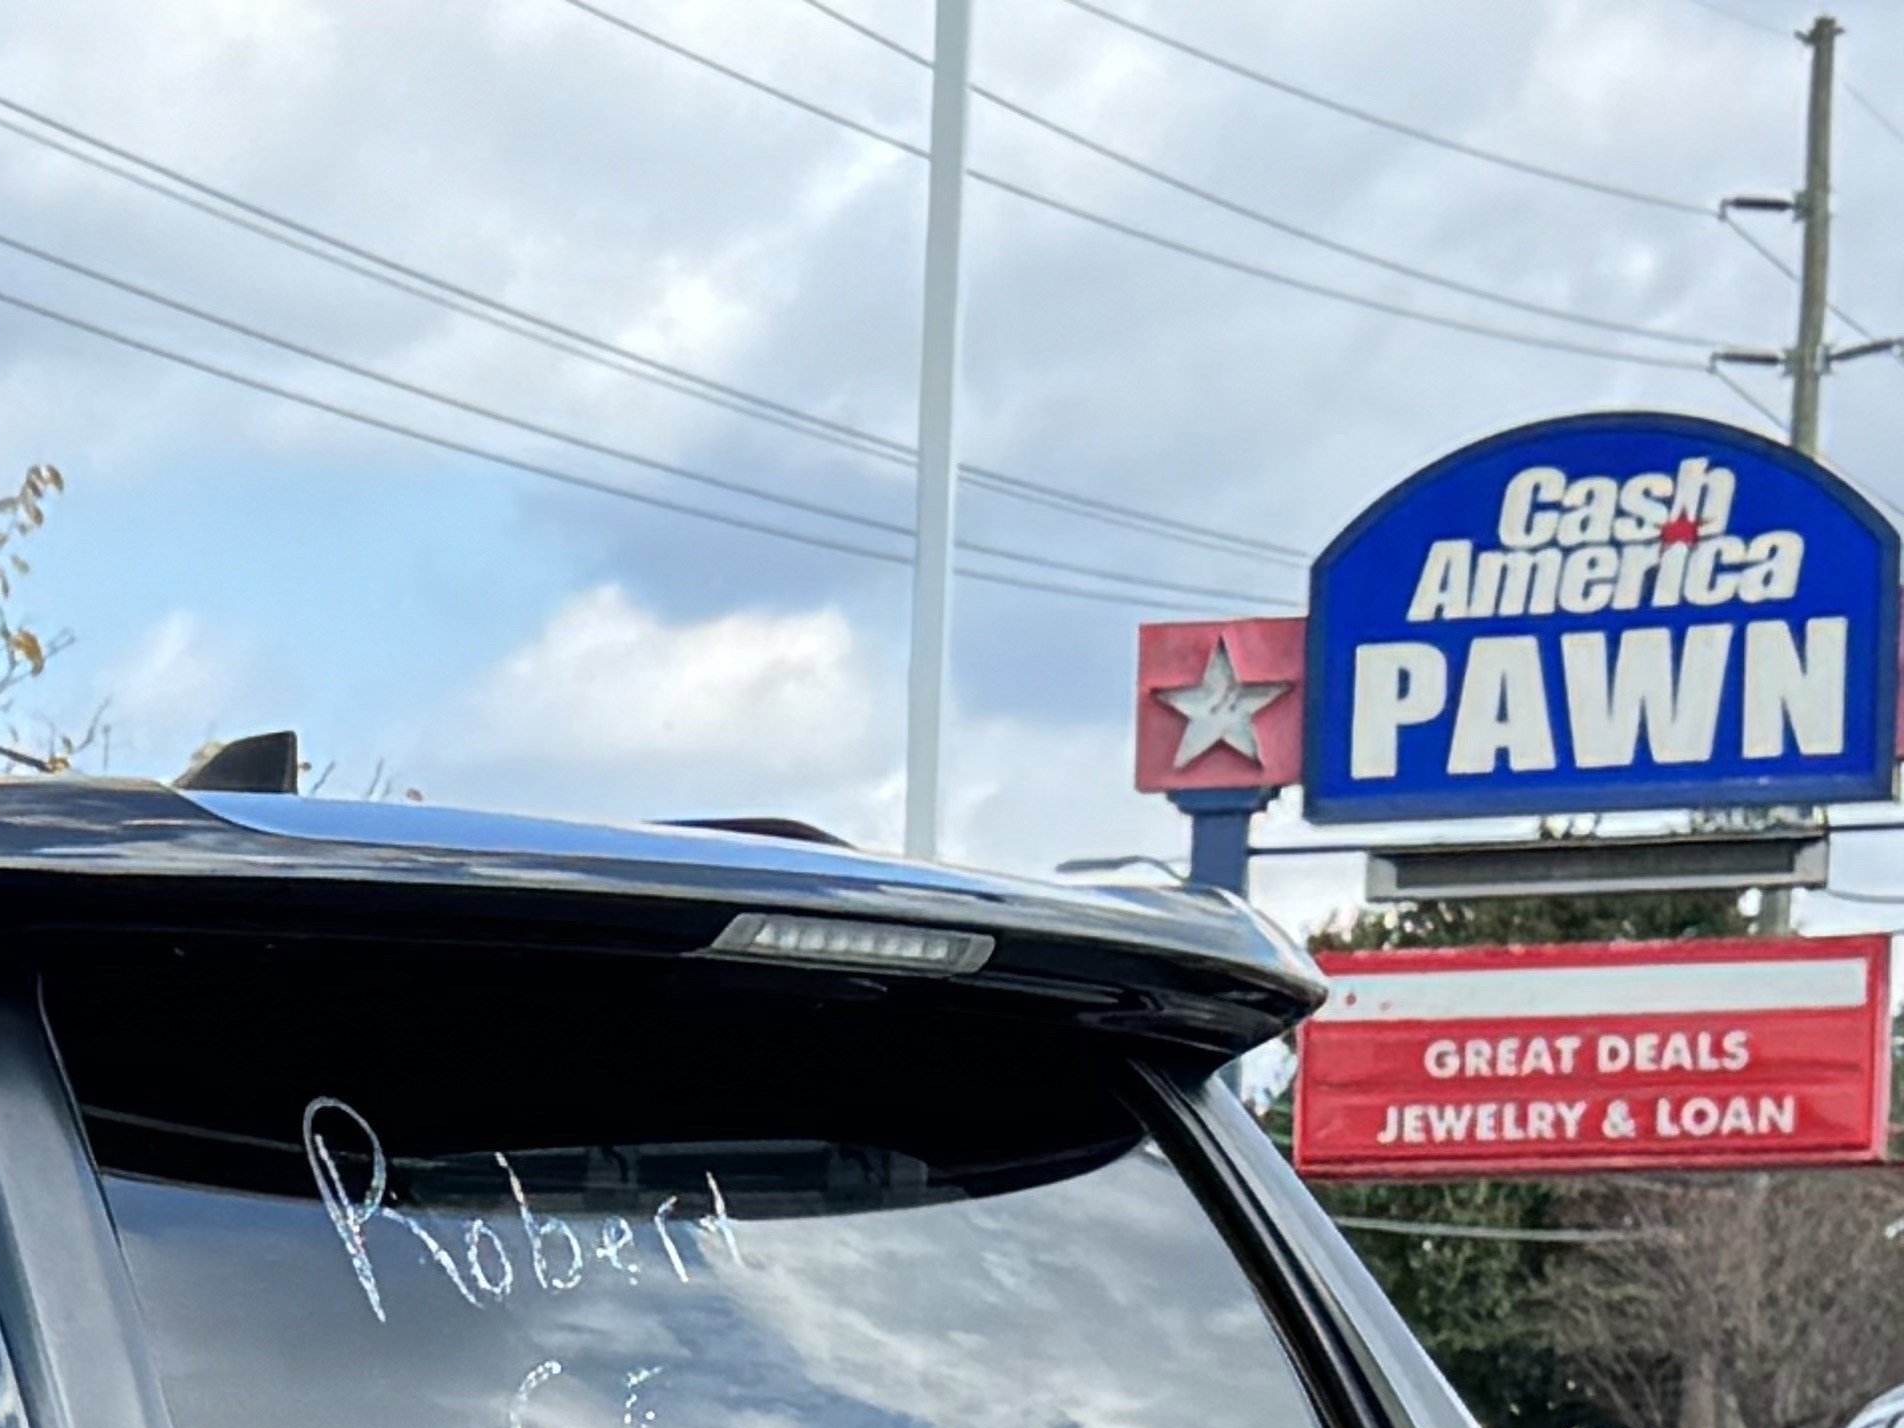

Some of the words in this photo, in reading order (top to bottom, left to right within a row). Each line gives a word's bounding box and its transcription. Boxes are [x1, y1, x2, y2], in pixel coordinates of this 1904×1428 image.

[1497, 456, 1736, 548] Cash
[1406, 530, 1805, 622] America
[1350, 616, 1849, 779] PAWN
[1423, 1035, 1580, 1080] GREAT
[1597, 1029, 1750, 1075] DEALS
[1376, 1100, 1587, 1146] JEWELRY
[1601, 1098, 1637, 1139] &
[1655, 1094, 1796, 1139] LOAN
[302, 1096, 748, 1324] Robert
